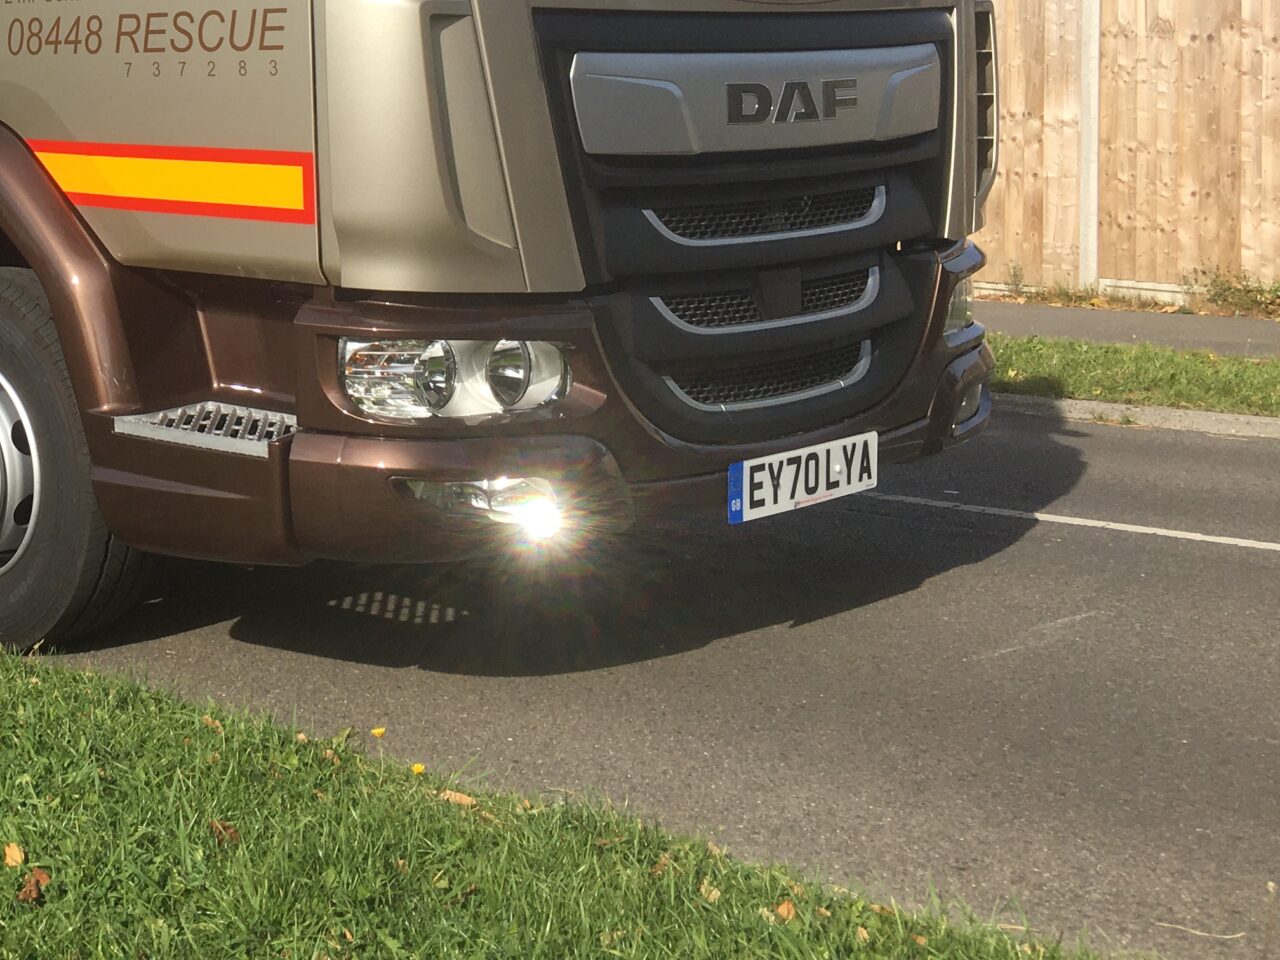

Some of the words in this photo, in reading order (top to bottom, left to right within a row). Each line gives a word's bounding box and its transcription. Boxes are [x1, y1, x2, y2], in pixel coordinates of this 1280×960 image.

[7, 14, 104, 56] 08448
[115, 7, 288, 54] RESCUE
[725, 78, 858, 126] DAF
[749, 451, 819, 510] EY70
[825, 440, 873, 491] LYA
[731, 498, 741, 512] GB
